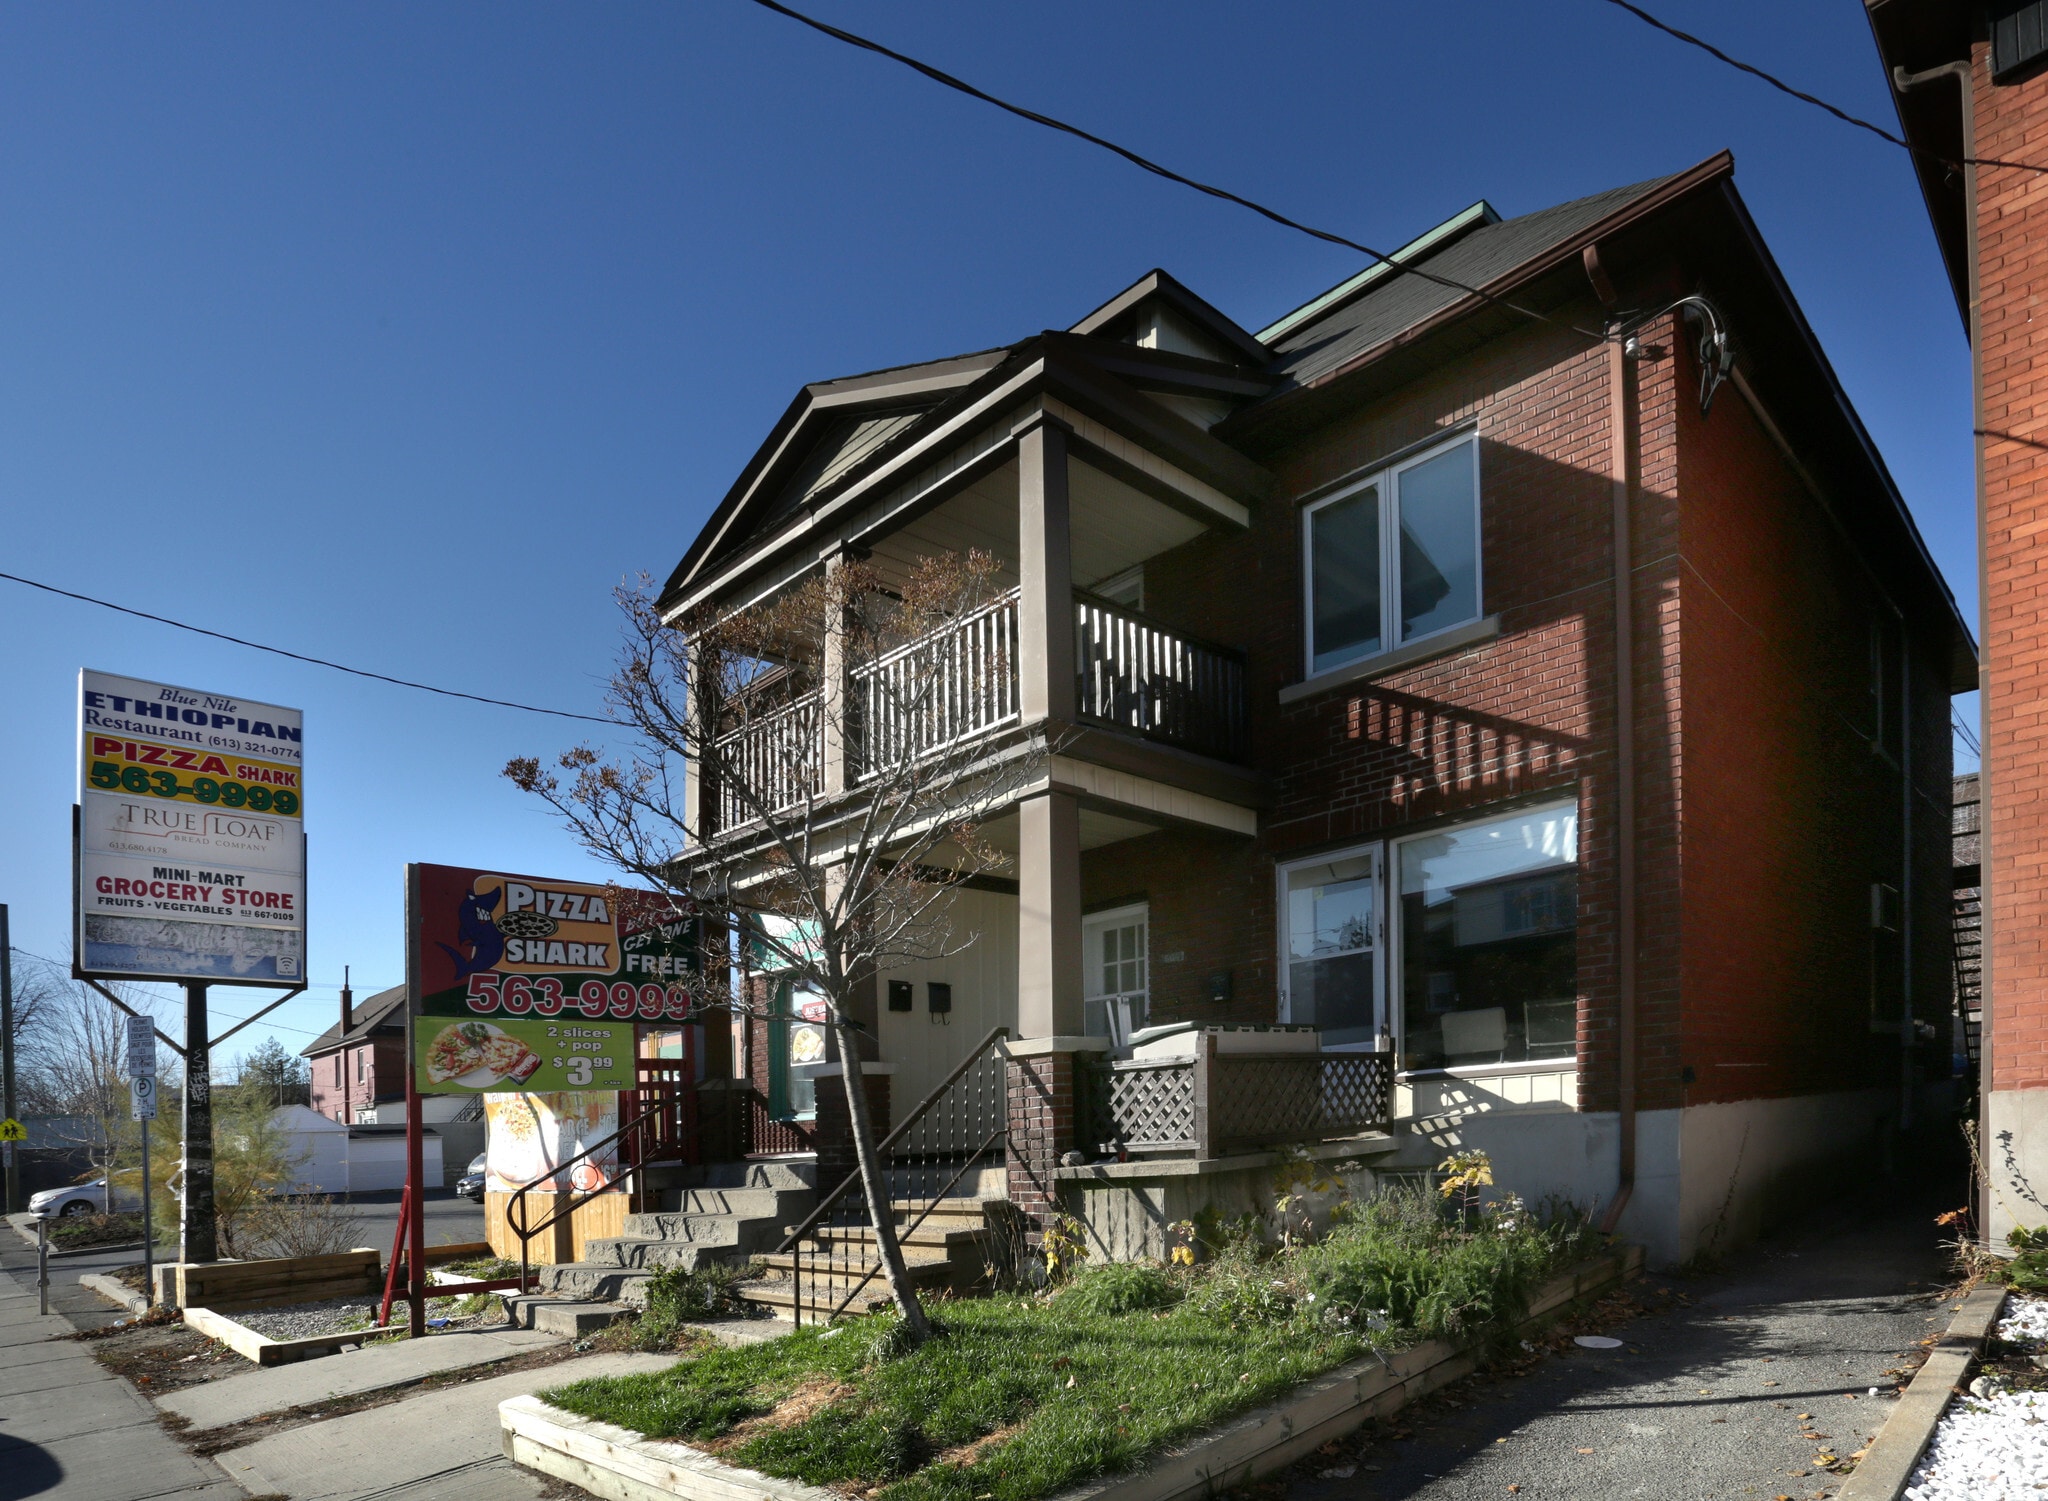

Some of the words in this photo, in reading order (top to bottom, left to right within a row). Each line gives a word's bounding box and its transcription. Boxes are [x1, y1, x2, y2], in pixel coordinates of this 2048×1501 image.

[158, 688, 199, 706] Blue
[202, 696, 238, 713] Nile
[85, 690, 301, 743] ETHIOPIAN
[85, 708, 203, 743] Restaurant
[208, 735, 241, 751] (613)
[244, 741, 301, 759] 321-0774
[93, 736, 230, 777] PIZZA
[237, 764, 297, 787] SHARK
[90, 761, 299, 815] 563-9999
[121, 803, 196, 831] TRUE
[213, 817, 276, 841] LOAF
[174, 834, 210, 845] BREAD
[215, 839, 268, 852] COMPANY
[152, 866, 245, 887] MINI-MART
[96, 876, 213, 902] GROCERY
[222, 888, 294, 910] STORE
[97, 896, 144, 908] FRUITS
[150, 901, 233, 916] VEGETABLES
[506, 882, 610, 924] PIZZA
[506, 939, 609, 968] SHARK
[624, 932, 653, 952] GET
[626, 954, 689, 975] FREE
[466, 973, 692, 1020] 563-9999
[547, 1027, 558, 1038] 2
[563, 1027, 612, 1038] slices
[572, 1041, 602, 1052] pop
